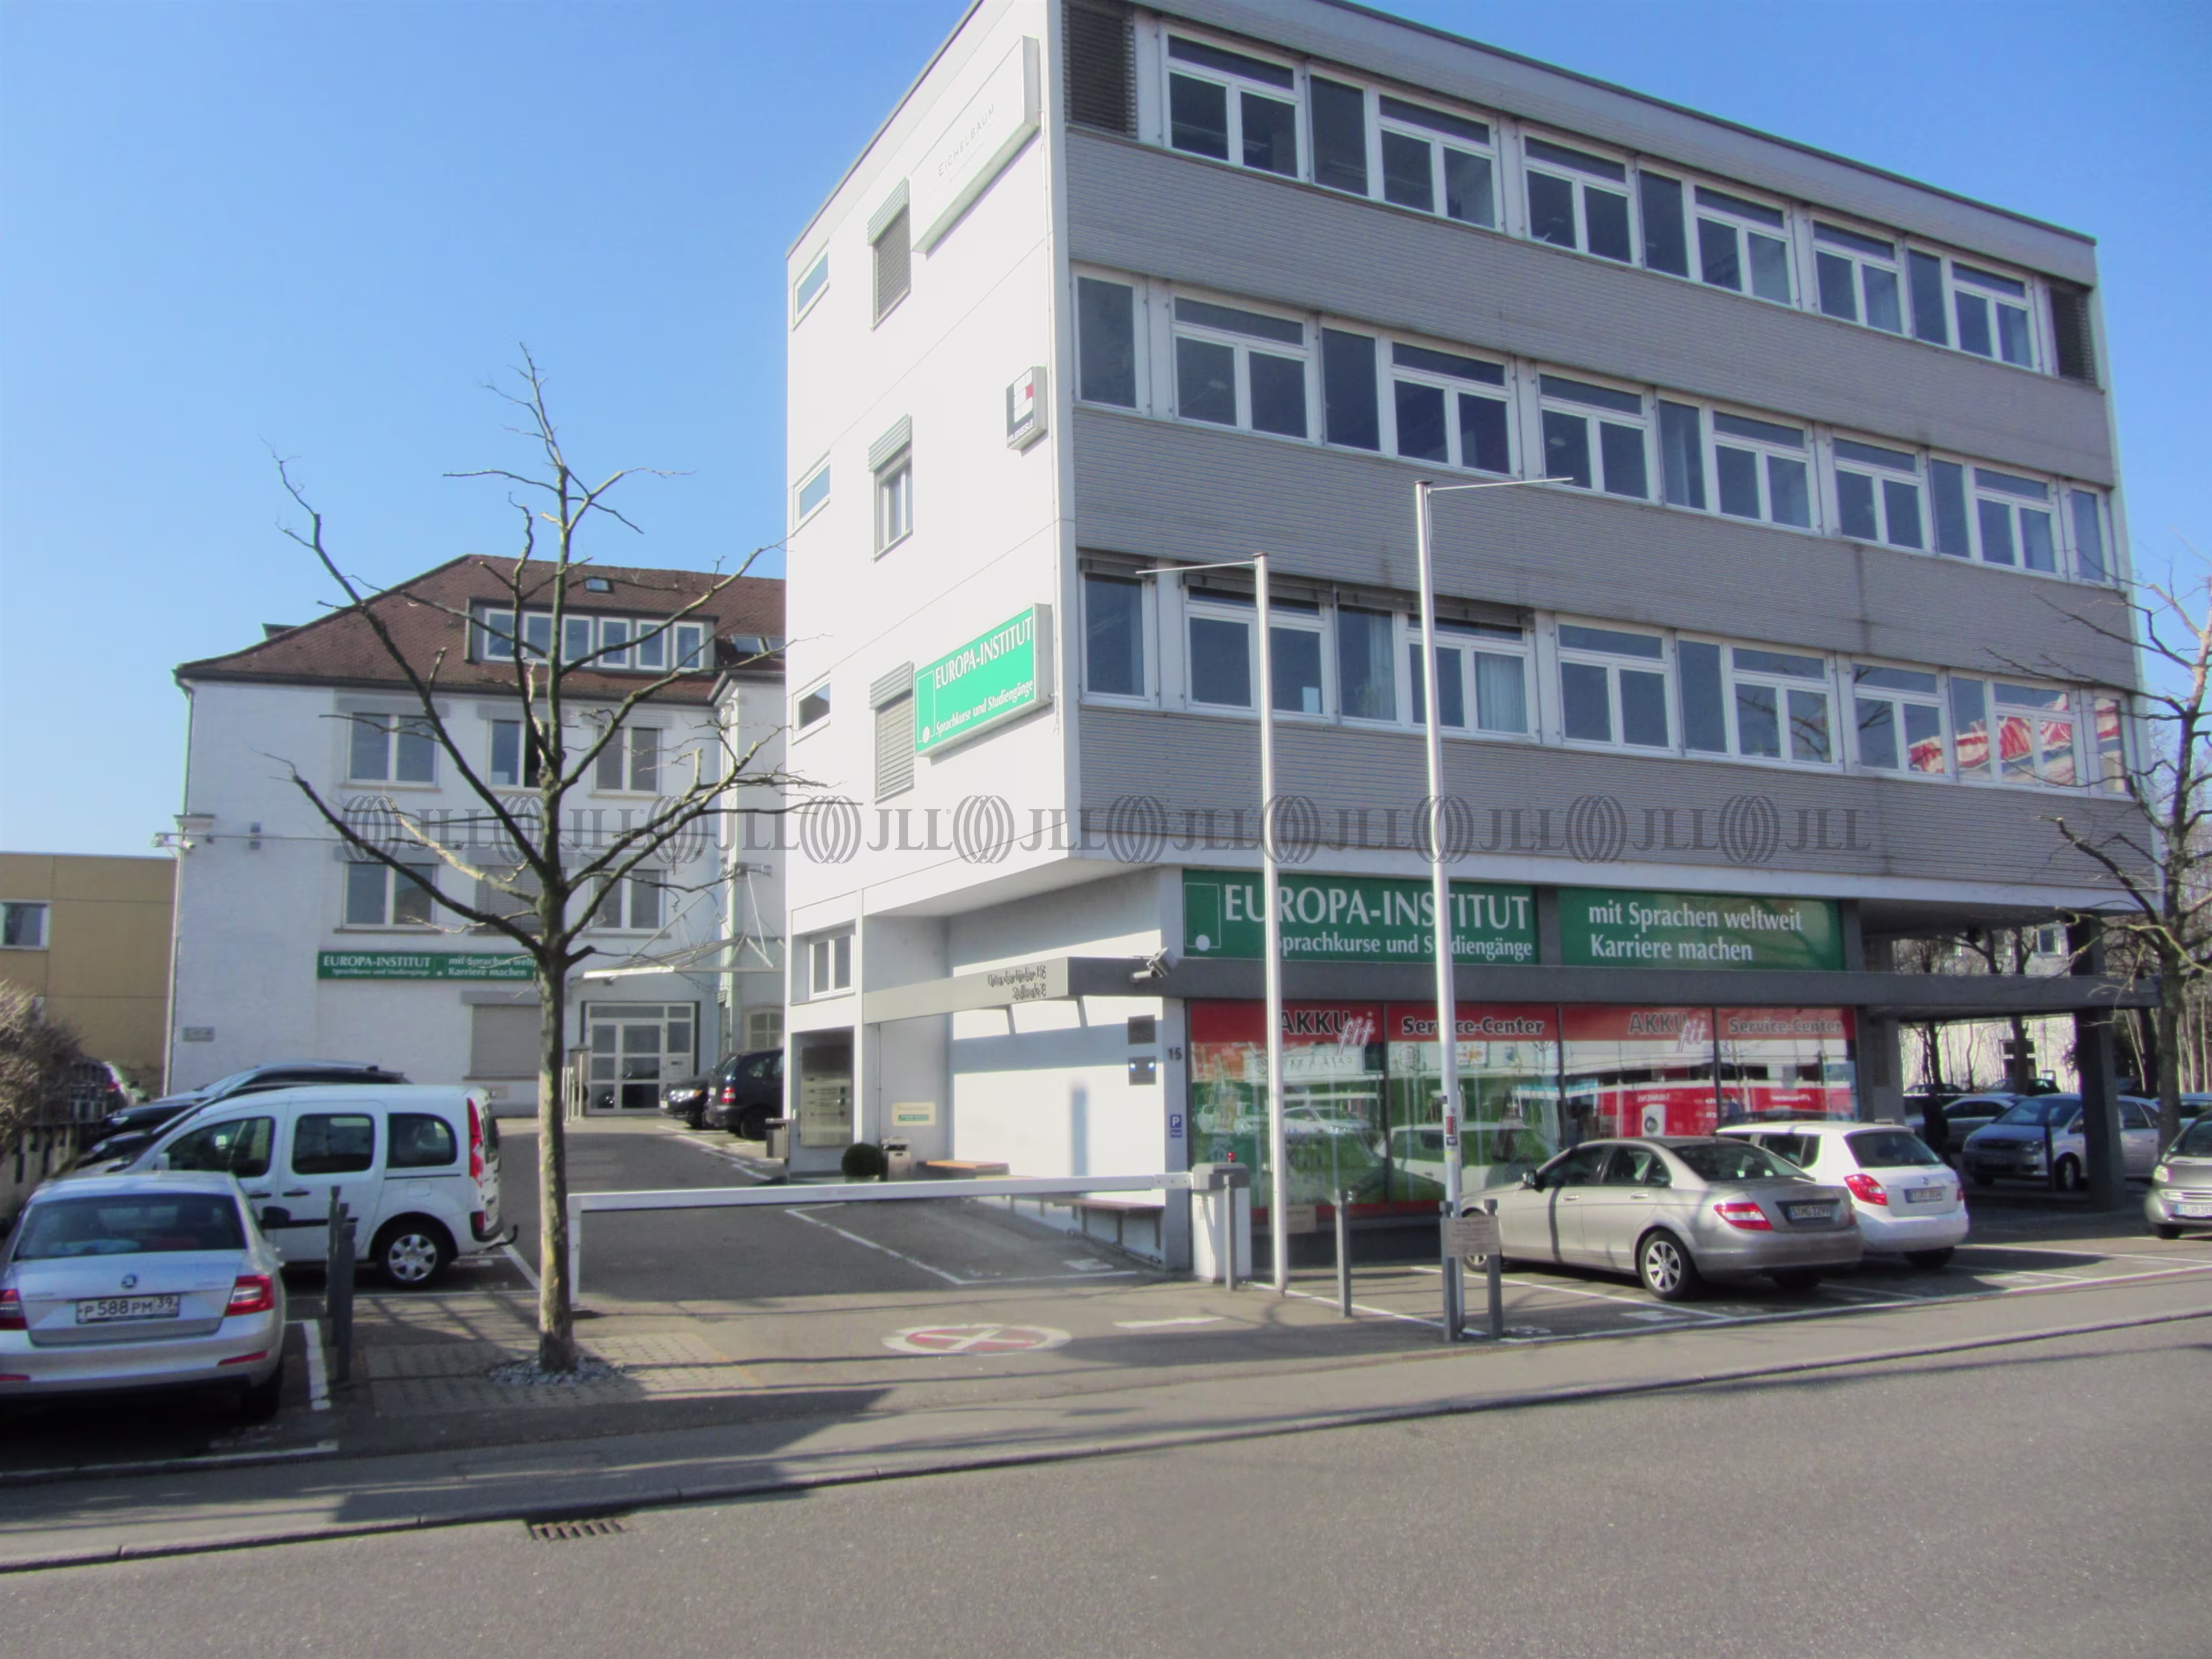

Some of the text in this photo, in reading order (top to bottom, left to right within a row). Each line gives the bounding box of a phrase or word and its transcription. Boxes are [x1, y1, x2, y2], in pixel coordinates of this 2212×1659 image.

[938, 104, 995, 177] EICHELBAUM
[935, 616, 1032, 690] EUROPA-INSTITUT
[937, 680, 1033, 737] Sprachkurse und Studiengänge
[1225, 884, 1529, 930] EUROPA-INSITUT
[1589, 899, 1803, 932] mit Sprachen weltweit
[1279, 931, 1532, 961] prachkurse und Sdiengänge
[1590, 933, 1753, 961] Karriere machen
[323, 955, 431, 968] EUROPA-INSTITUT
[448, 967, 527, 976] Karriere machen
[1282, 1010, 1350, 1035] AKKU
[1402, 1016, 1544, 1035] Serce-Center
[1627, 1012, 1688, 1035] AKKU
[1728, 1016, 1843, 1035] Service-Center
[1168, 1047, 1182, 1060] 15
[1172, 1116, 1180, 1127] P
